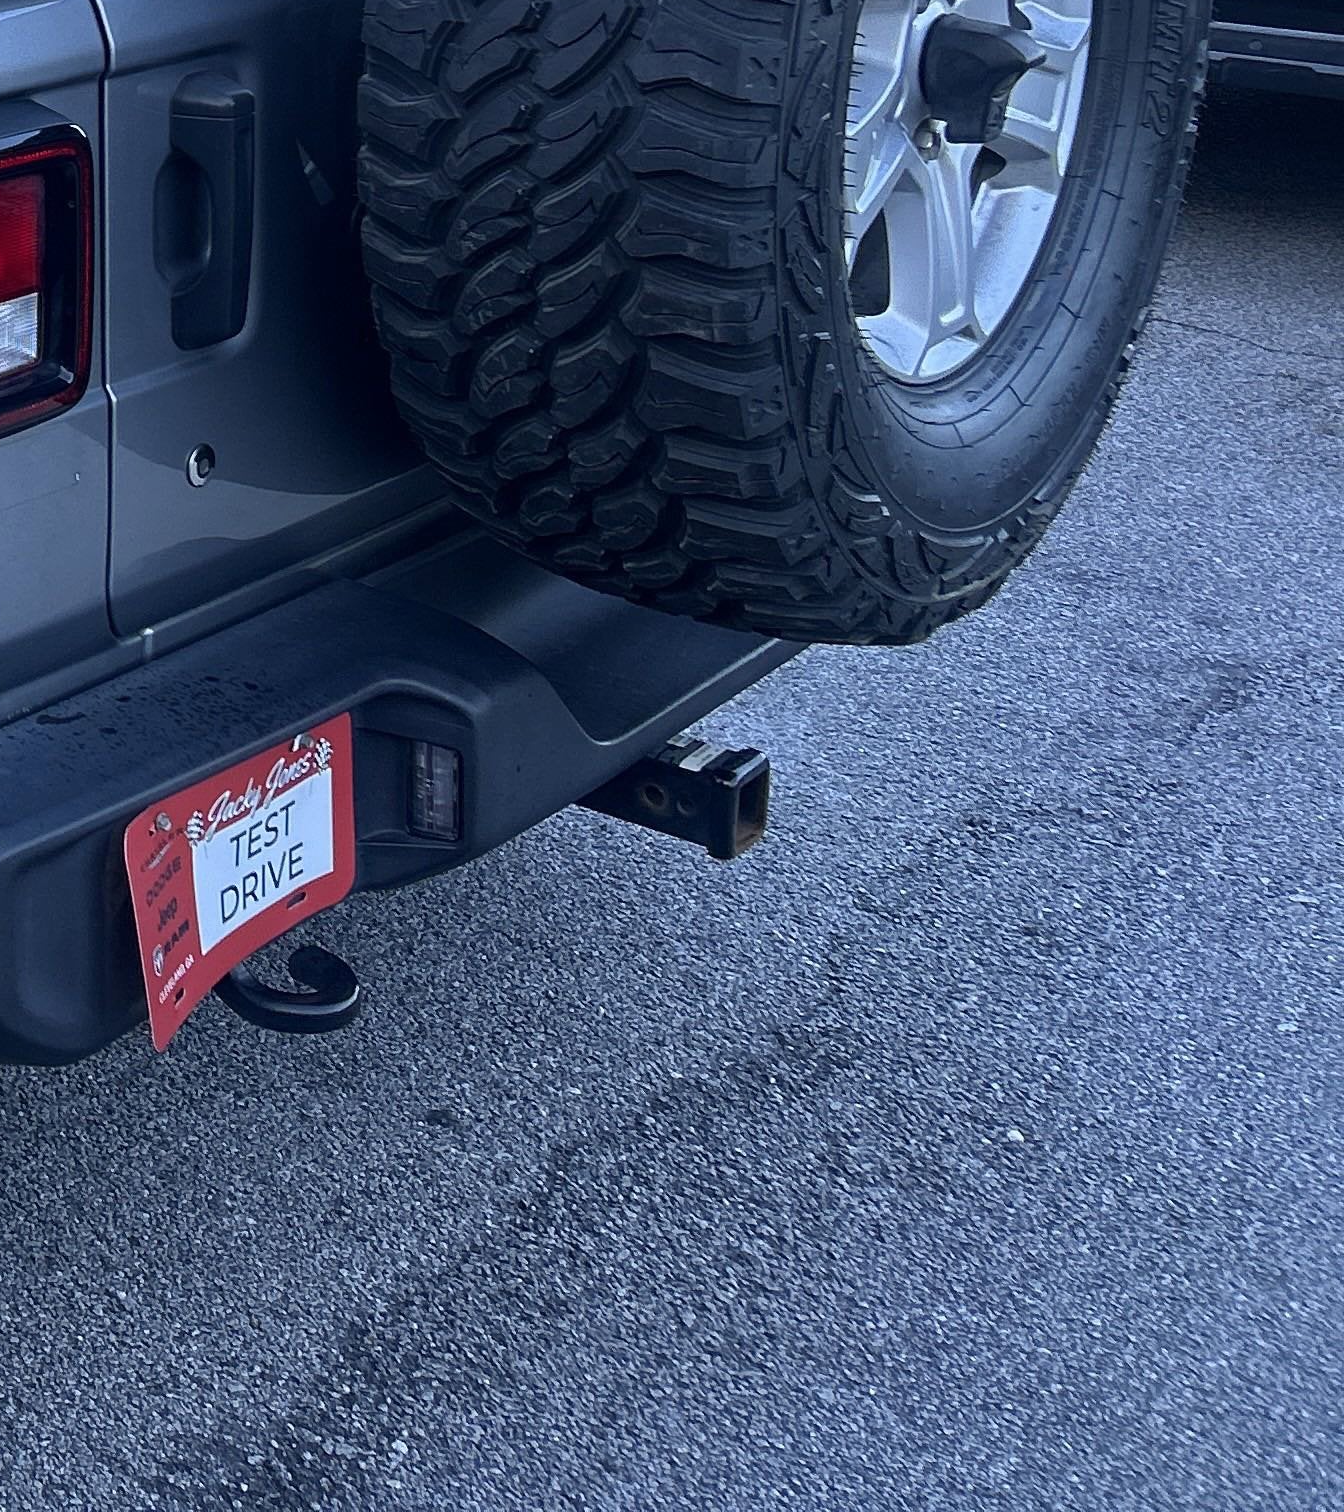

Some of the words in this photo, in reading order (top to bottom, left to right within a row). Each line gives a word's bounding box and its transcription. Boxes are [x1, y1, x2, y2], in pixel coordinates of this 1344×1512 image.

[205, 776, 262, 843] Jacky
[262, 751, 313, 809] Jones
[230, 800, 296, 867] TEST
[219, 841, 304, 924] DRIVE
